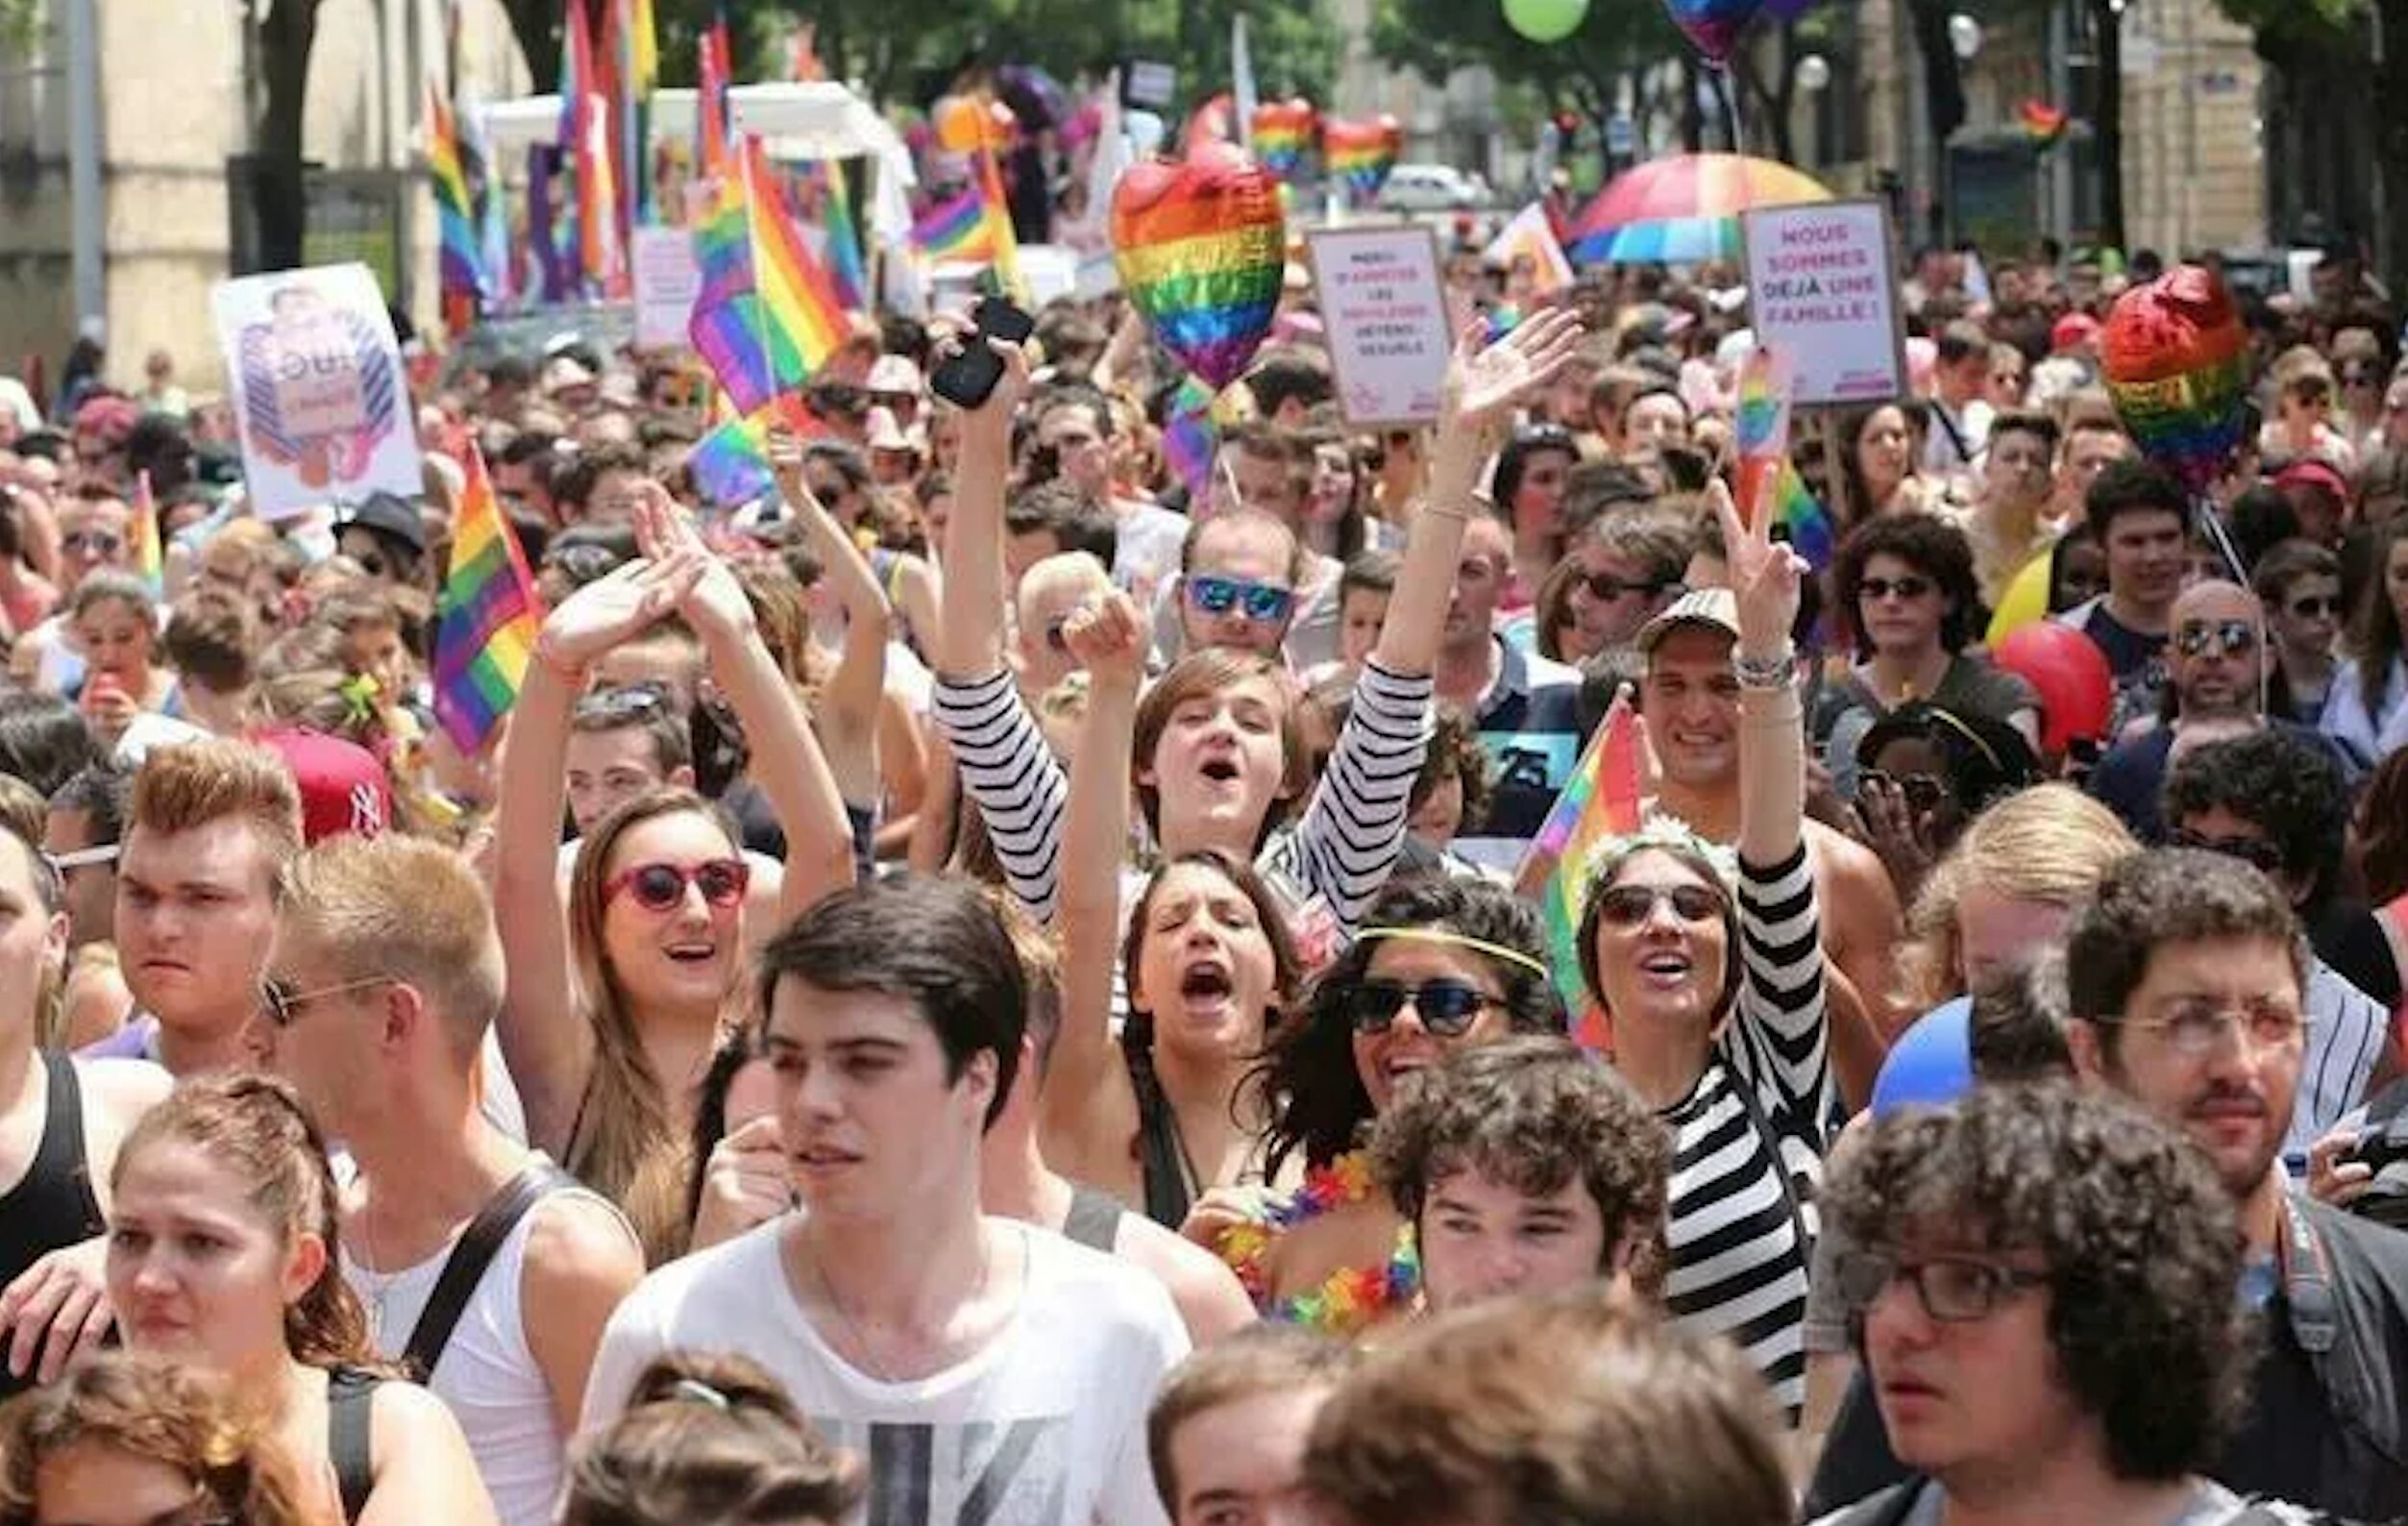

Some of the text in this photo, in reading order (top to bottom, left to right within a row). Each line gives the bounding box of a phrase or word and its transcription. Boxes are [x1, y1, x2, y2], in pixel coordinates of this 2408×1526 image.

[1781, 224, 1849, 245] NOUS
[1767, 249, 1867, 273] SOMMES
[1829, 276, 1874, 295] UNE
